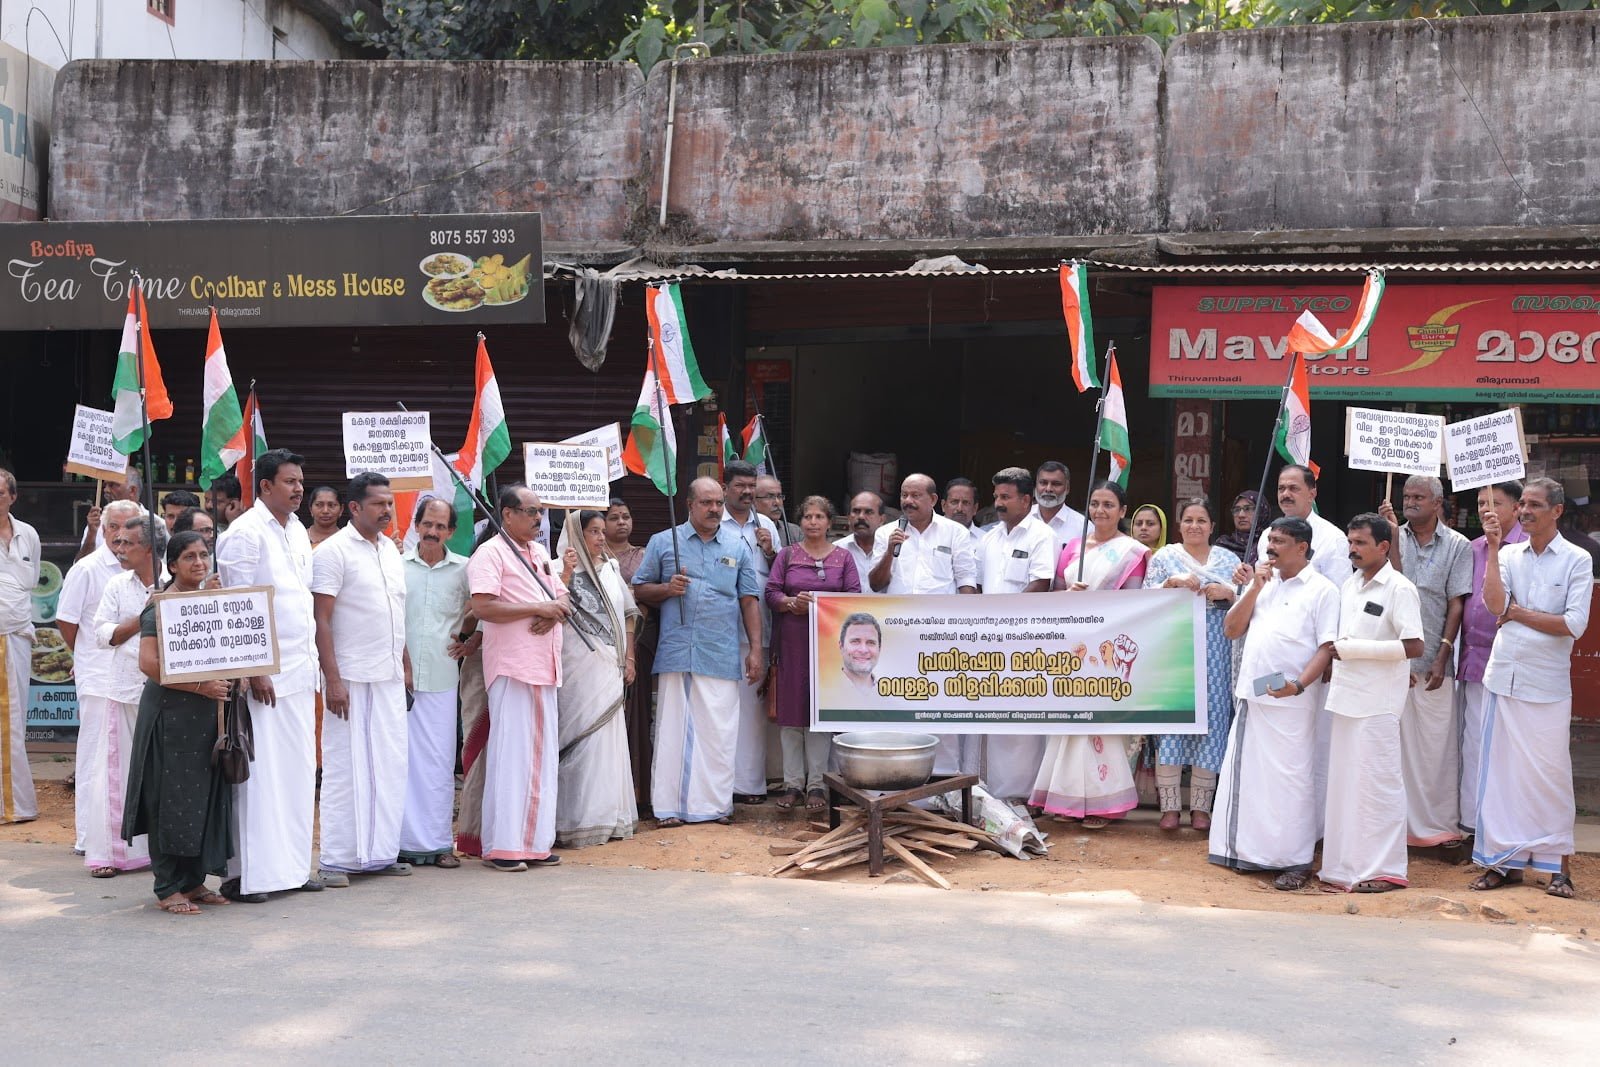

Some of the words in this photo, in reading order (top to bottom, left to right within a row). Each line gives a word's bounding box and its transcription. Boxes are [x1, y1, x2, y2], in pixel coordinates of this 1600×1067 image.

[430, 230, 461, 245] 8075
[465, 229, 488, 244] 557
[492, 228, 516, 243] 393
[30, 240, 96, 260] Boofiya
[8, 259, 82, 302] Tea
[190, 274, 267, 299] Coolbar
[273, 282, 282, 297] &
[287, 273, 337, 297] Mess
[343, 272, 406, 297] House
[1197, 296, 1352, 312] SUPPLYCO
[1168, 328, 1370, 361] Mavli
[1305, 364, 1370, 376] tore
[1168, 375, 1242, 383] Thiruvambadi
[368, 429, 406, 440] ജനങ്ങളെ
[1357, 422, 1373, 433] വില
[353, 440, 424, 453] കൊള്ളയടിക്കുന്ന
[1359, 435, 1391, 447] കൊള്ള
[1394, 438, 1433, 450] സർക്കാർ
[389, 453, 429, 465] തുലയട്ടെ
[1371, 447, 1420, 463] തുലയട്ടെ
[1485, 453, 1521, 470] തുലയട്ടെ
[549, 461, 585, 471] ജനങ്ങളെ
[535, 471, 601, 482] കൊള്ളയടിക്കുന്ന
[570, 483, 607, 495] തുലയട്ടെ
[180, 599, 219, 617] മാവേലി
[168, 618, 223, 637] പൂട്ടിക്കുന്ന
[227, 615, 265, 630] കൊള്ള
[168, 635, 216, 652] സർക്കാർ
[220, 632, 267, 650] തുലയട്ടെ
[960, 631, 978, 642] വെട്ടി
[918, 647, 1005, 674] പ്രതിഷേധ
[1011, 648, 1082, 676] മാർച്ചും
[878, 676, 939, 701] വെള്ളം
[944, 672, 1047, 701] തിളപ്പിക്കൽ
[1052, 677, 1132, 701] സമരവും
